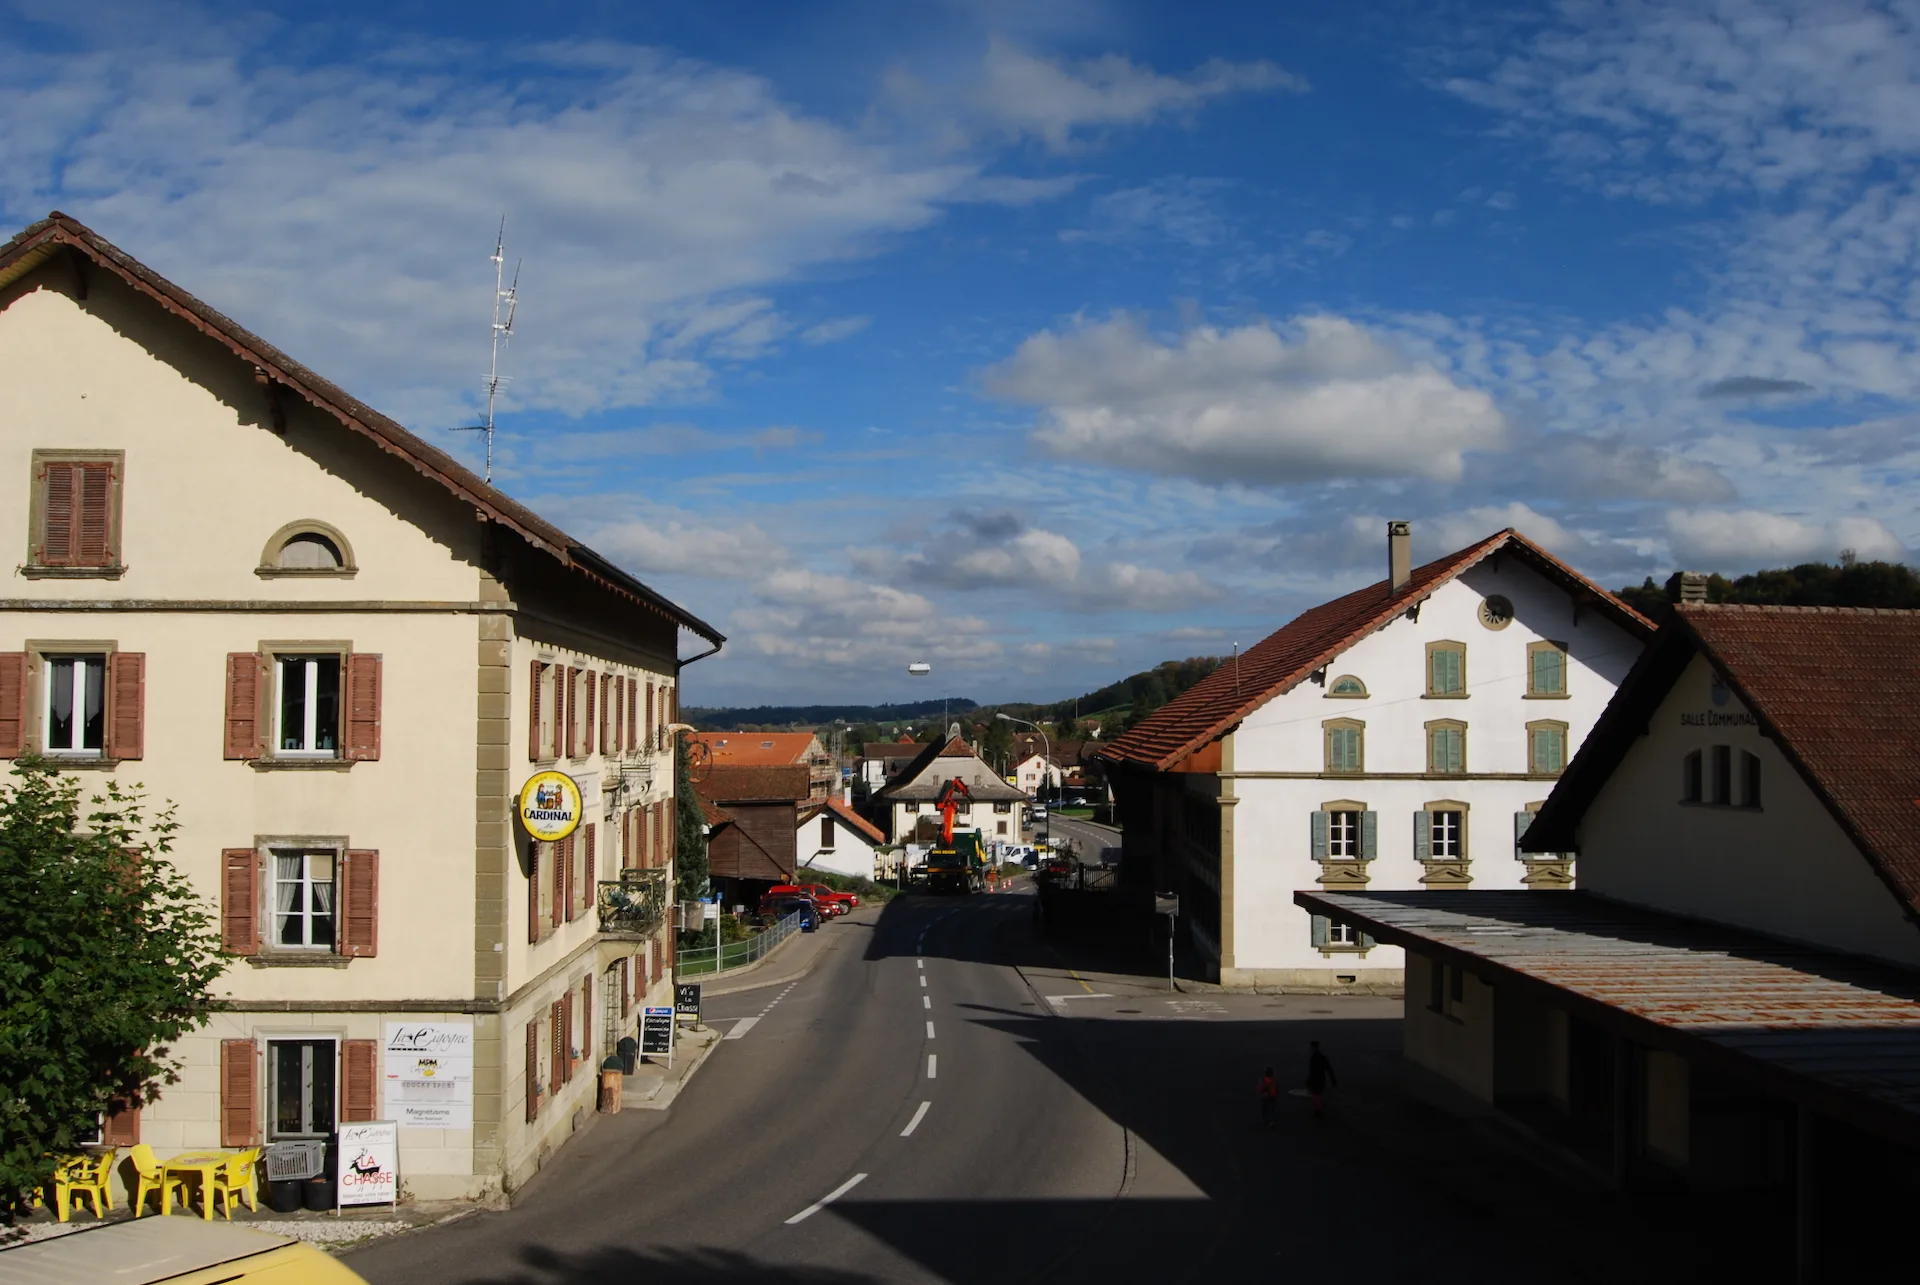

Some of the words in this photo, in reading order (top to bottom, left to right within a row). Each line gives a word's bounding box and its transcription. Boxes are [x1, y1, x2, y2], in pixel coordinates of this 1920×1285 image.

[1680, 713, 1705, 726] SALLE
[524, 808, 574, 821] CARDINAL
[388, 1027, 406, 1047] La
[413, 1027, 469, 1052] Cigogne
[360, 1156, 376, 1168] LA
[342, 1172, 392, 1186] CHASSE
